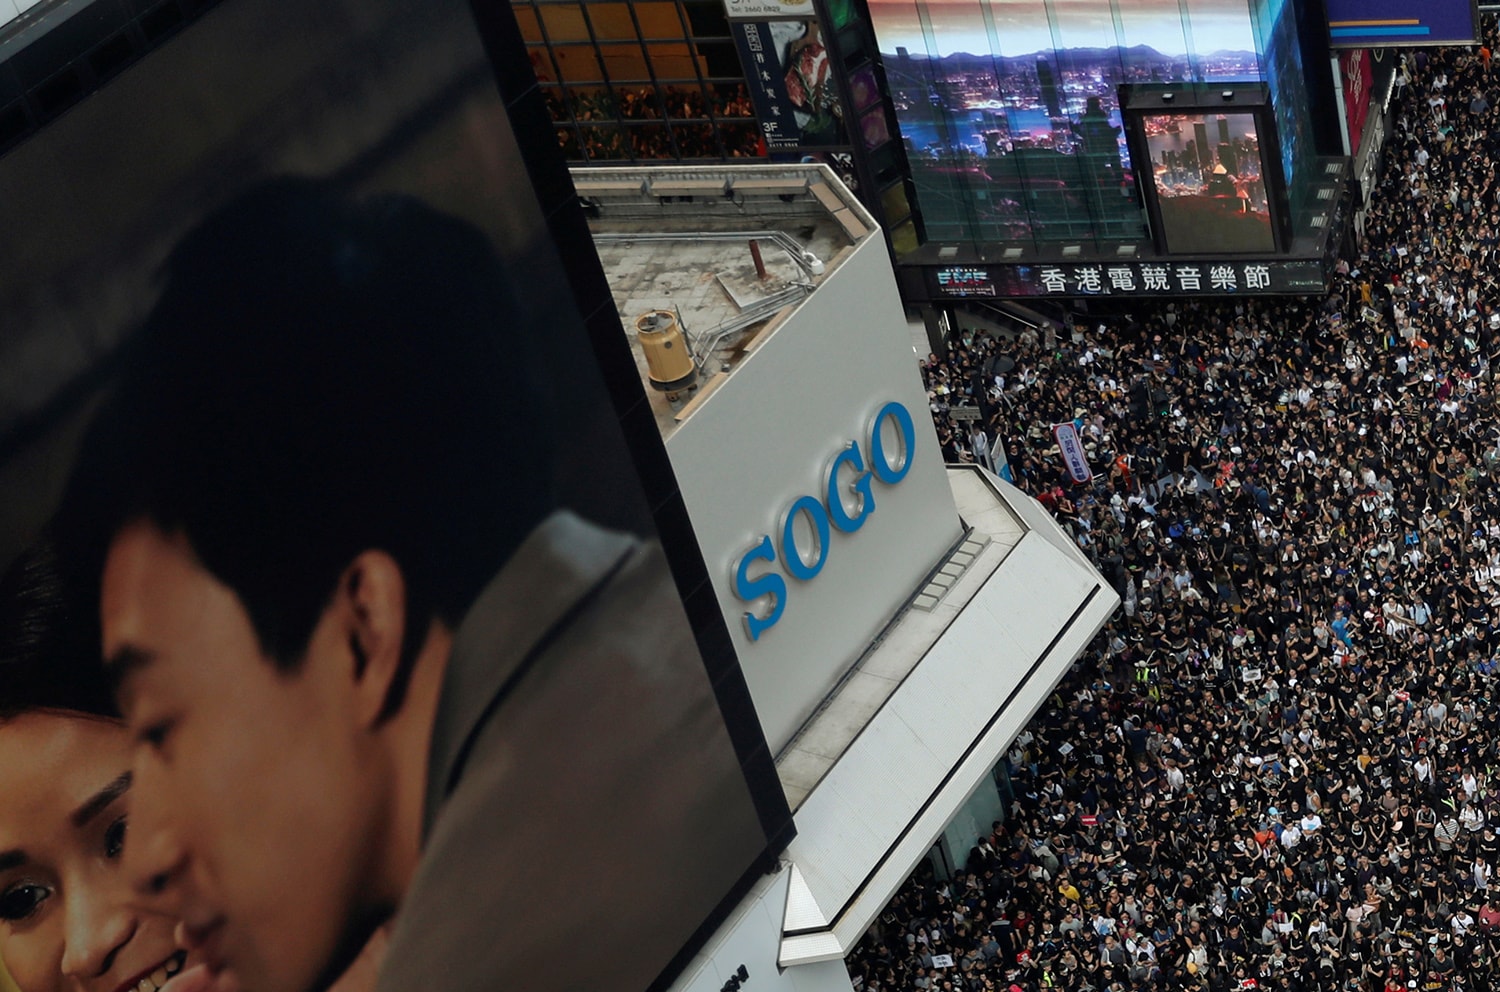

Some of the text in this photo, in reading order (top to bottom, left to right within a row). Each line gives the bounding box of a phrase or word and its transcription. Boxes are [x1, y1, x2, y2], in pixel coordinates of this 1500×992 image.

[763, 122, 778, 132] 3F
[1040, 264, 1271, 292] 香港電競音樂節
[732, 401, 915, 641] SOGO
